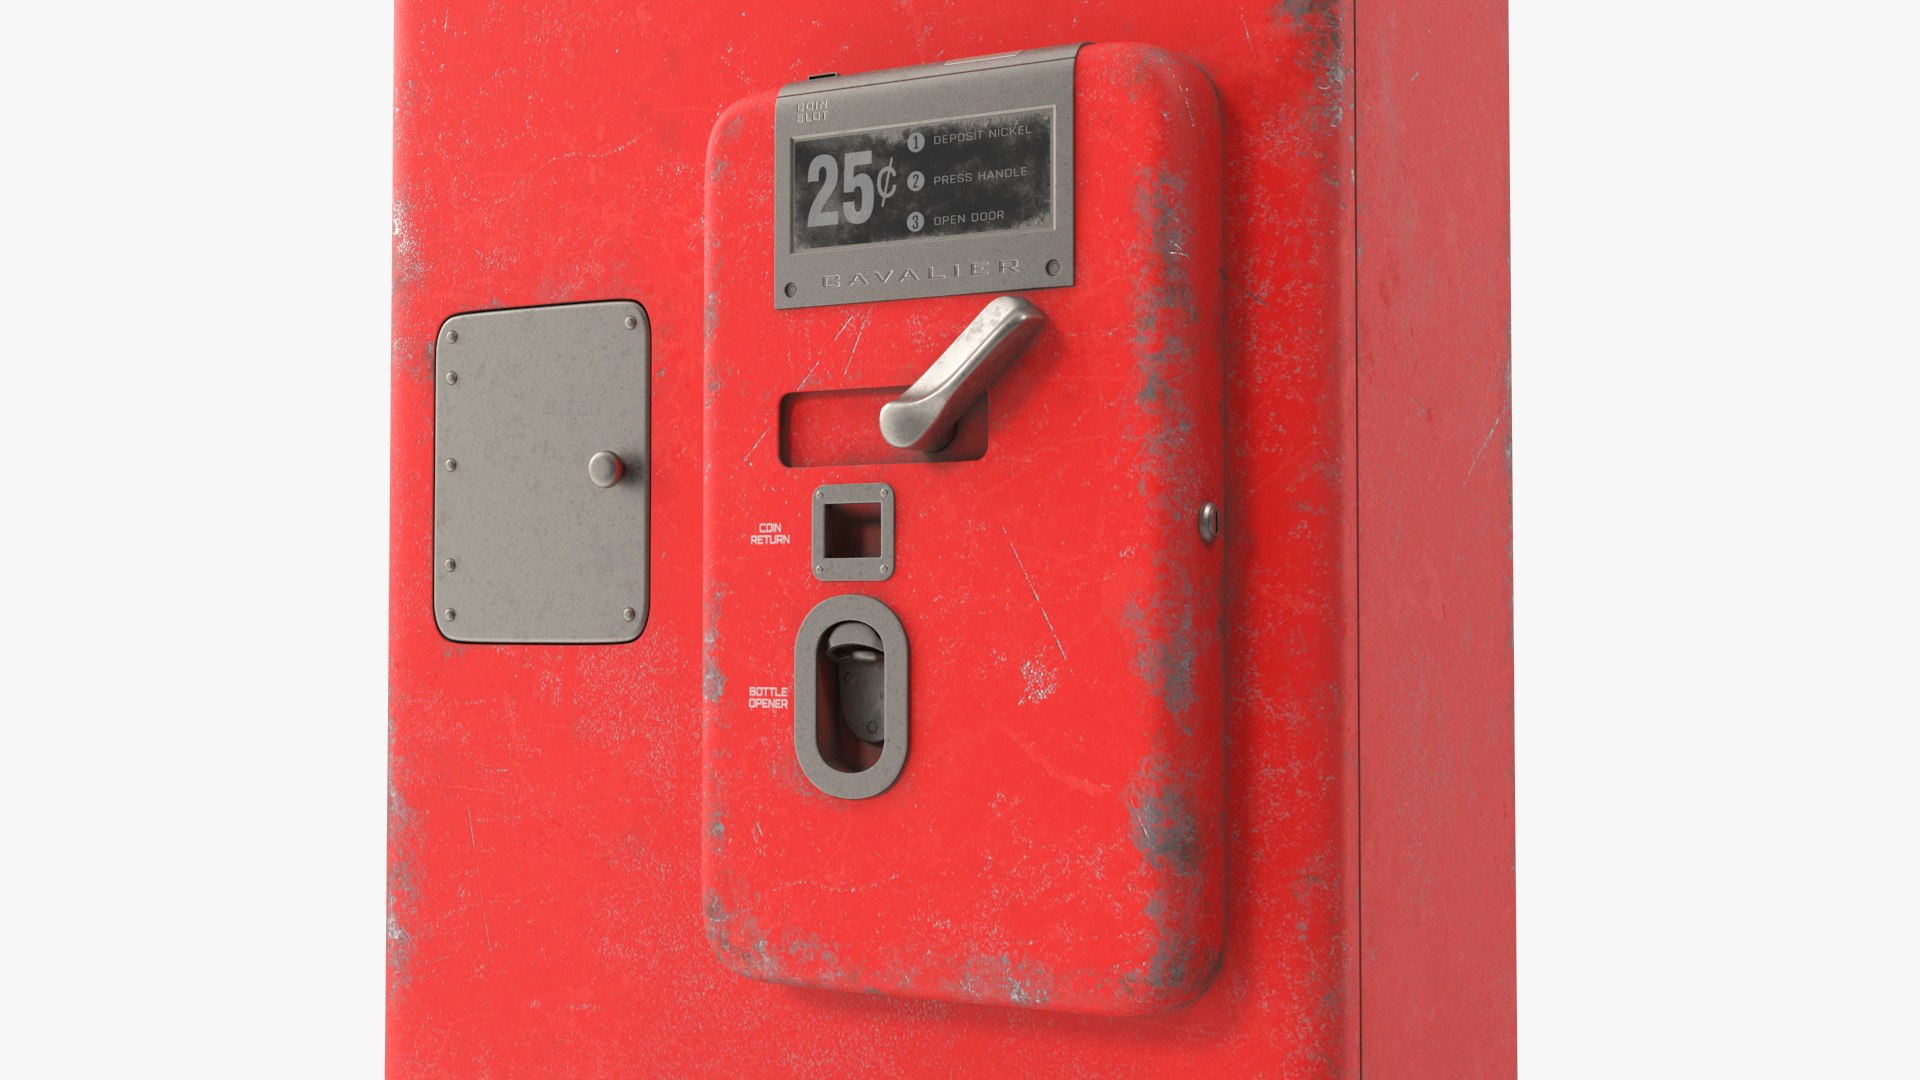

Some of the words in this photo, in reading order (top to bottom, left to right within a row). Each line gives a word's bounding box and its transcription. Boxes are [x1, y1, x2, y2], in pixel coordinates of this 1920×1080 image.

[796, 110, 829, 123] SLOT
[933, 129, 983, 145] DEPOSIT
[988, 125, 1032, 137] NICKEL
[933, 172, 973, 185] PRESS
[978, 166, 1028, 181] HANDLE
[933, 214, 966, 226] OPEN
[971, 209, 1005, 223] DOOR
[822, 259, 1020, 288] CAVALIER
[759, 522, 782, 534] COIN
[750, 533, 790, 545] RETURN
[749, 686, 788, 698] BOTTLE
[748, 697, 789, 709] OPENER
